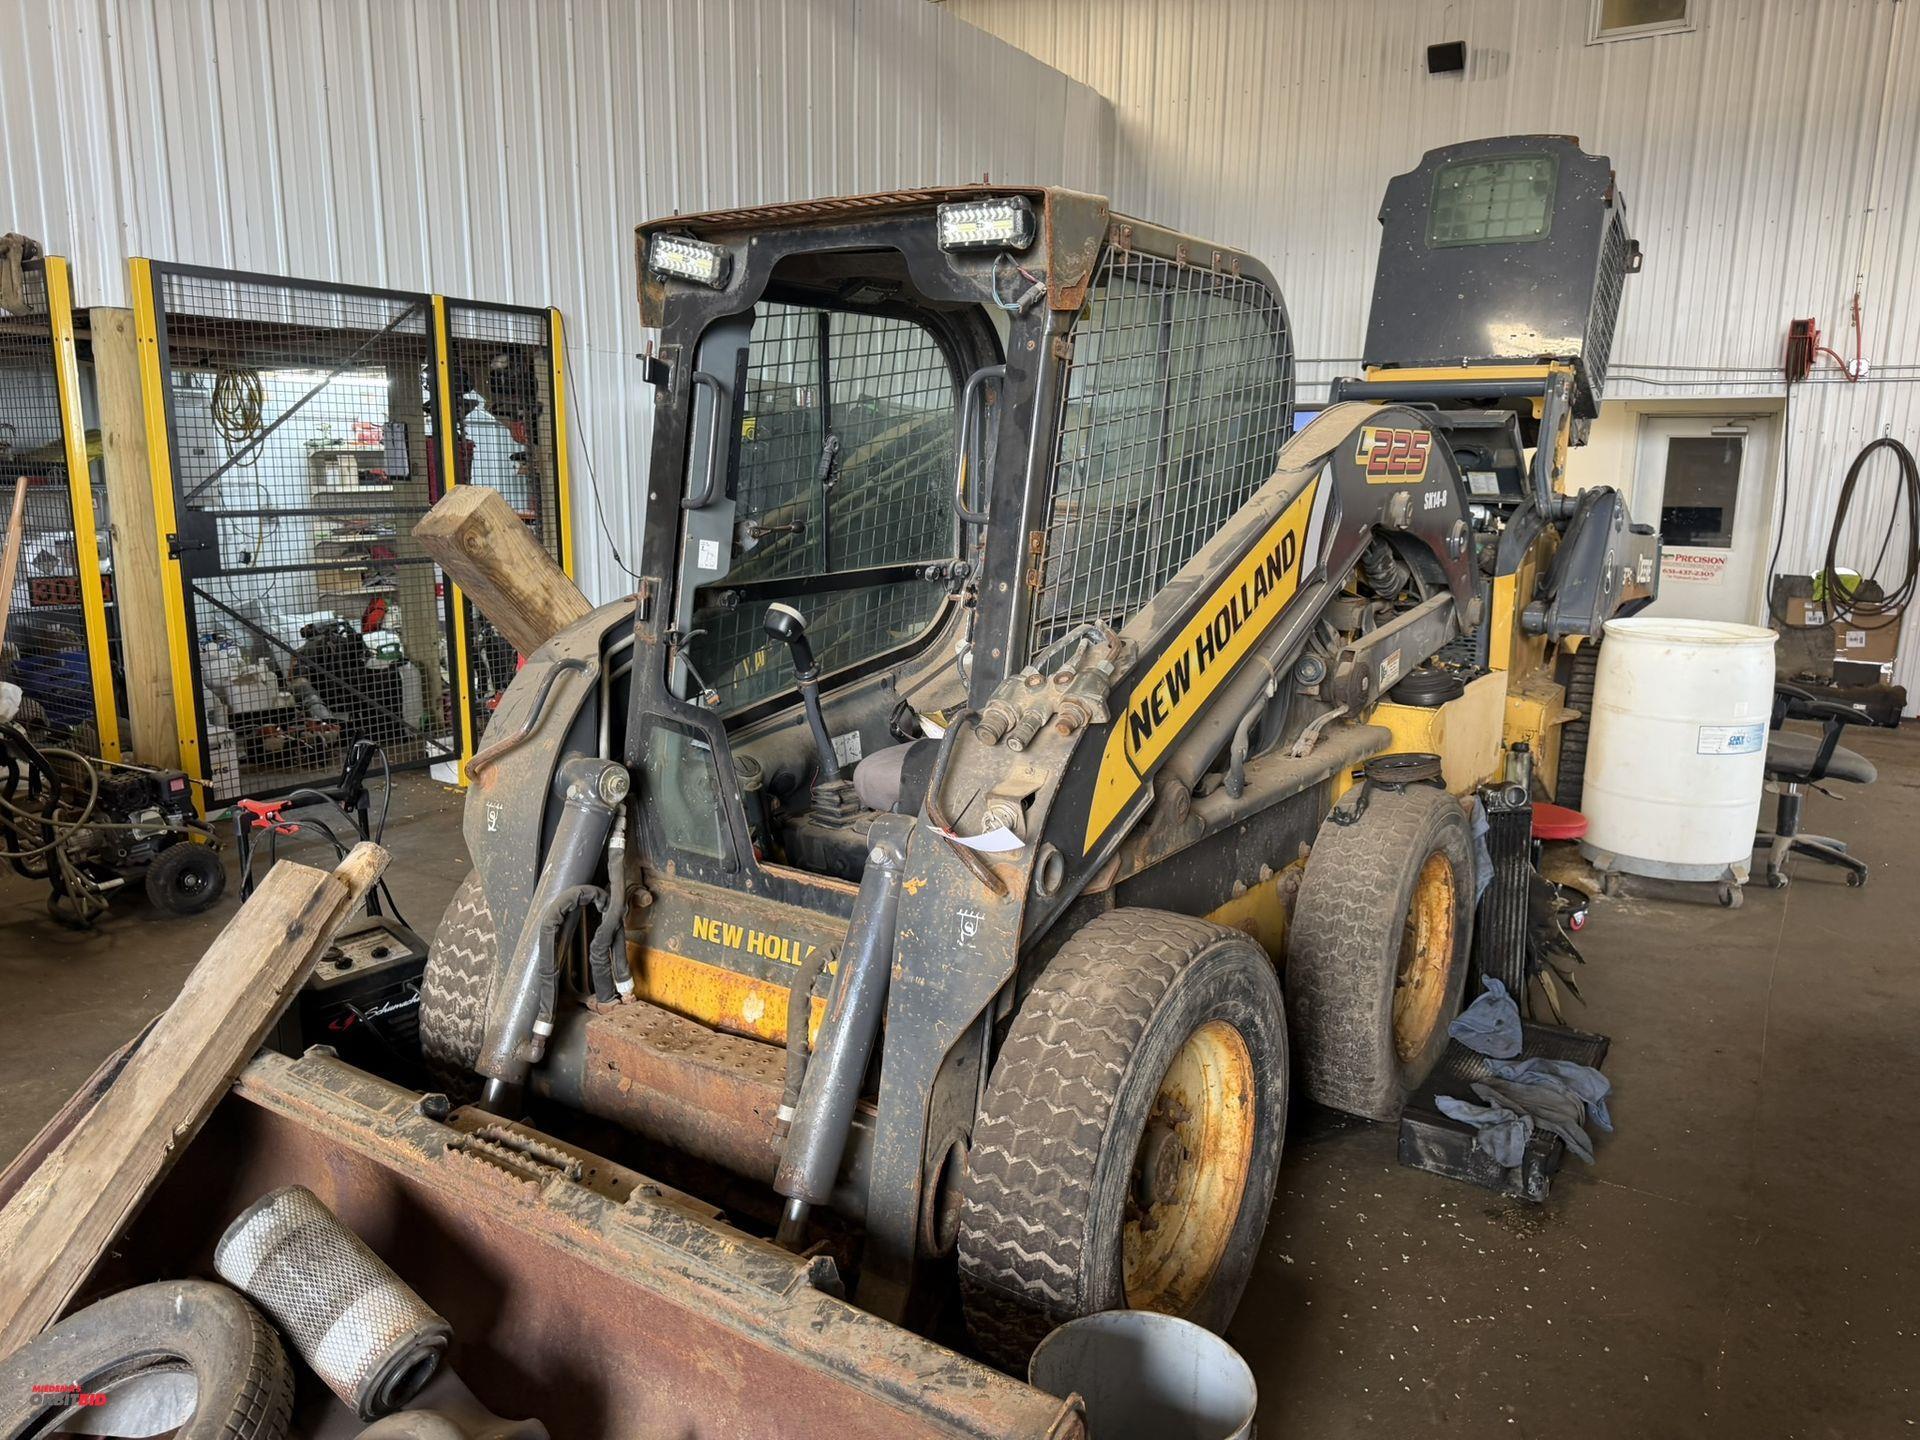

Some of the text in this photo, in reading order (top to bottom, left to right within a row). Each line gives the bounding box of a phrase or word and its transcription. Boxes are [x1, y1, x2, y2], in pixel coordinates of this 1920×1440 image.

[1356, 427, 1432, 484] L225
[1675, 553, 1726, 565] PRECISION
[1129, 529, 1297, 754] NEW HOLLAND
[692, 915, 839, 977] NEW HOLL
[364, 993, 421, 1021] Schumach
